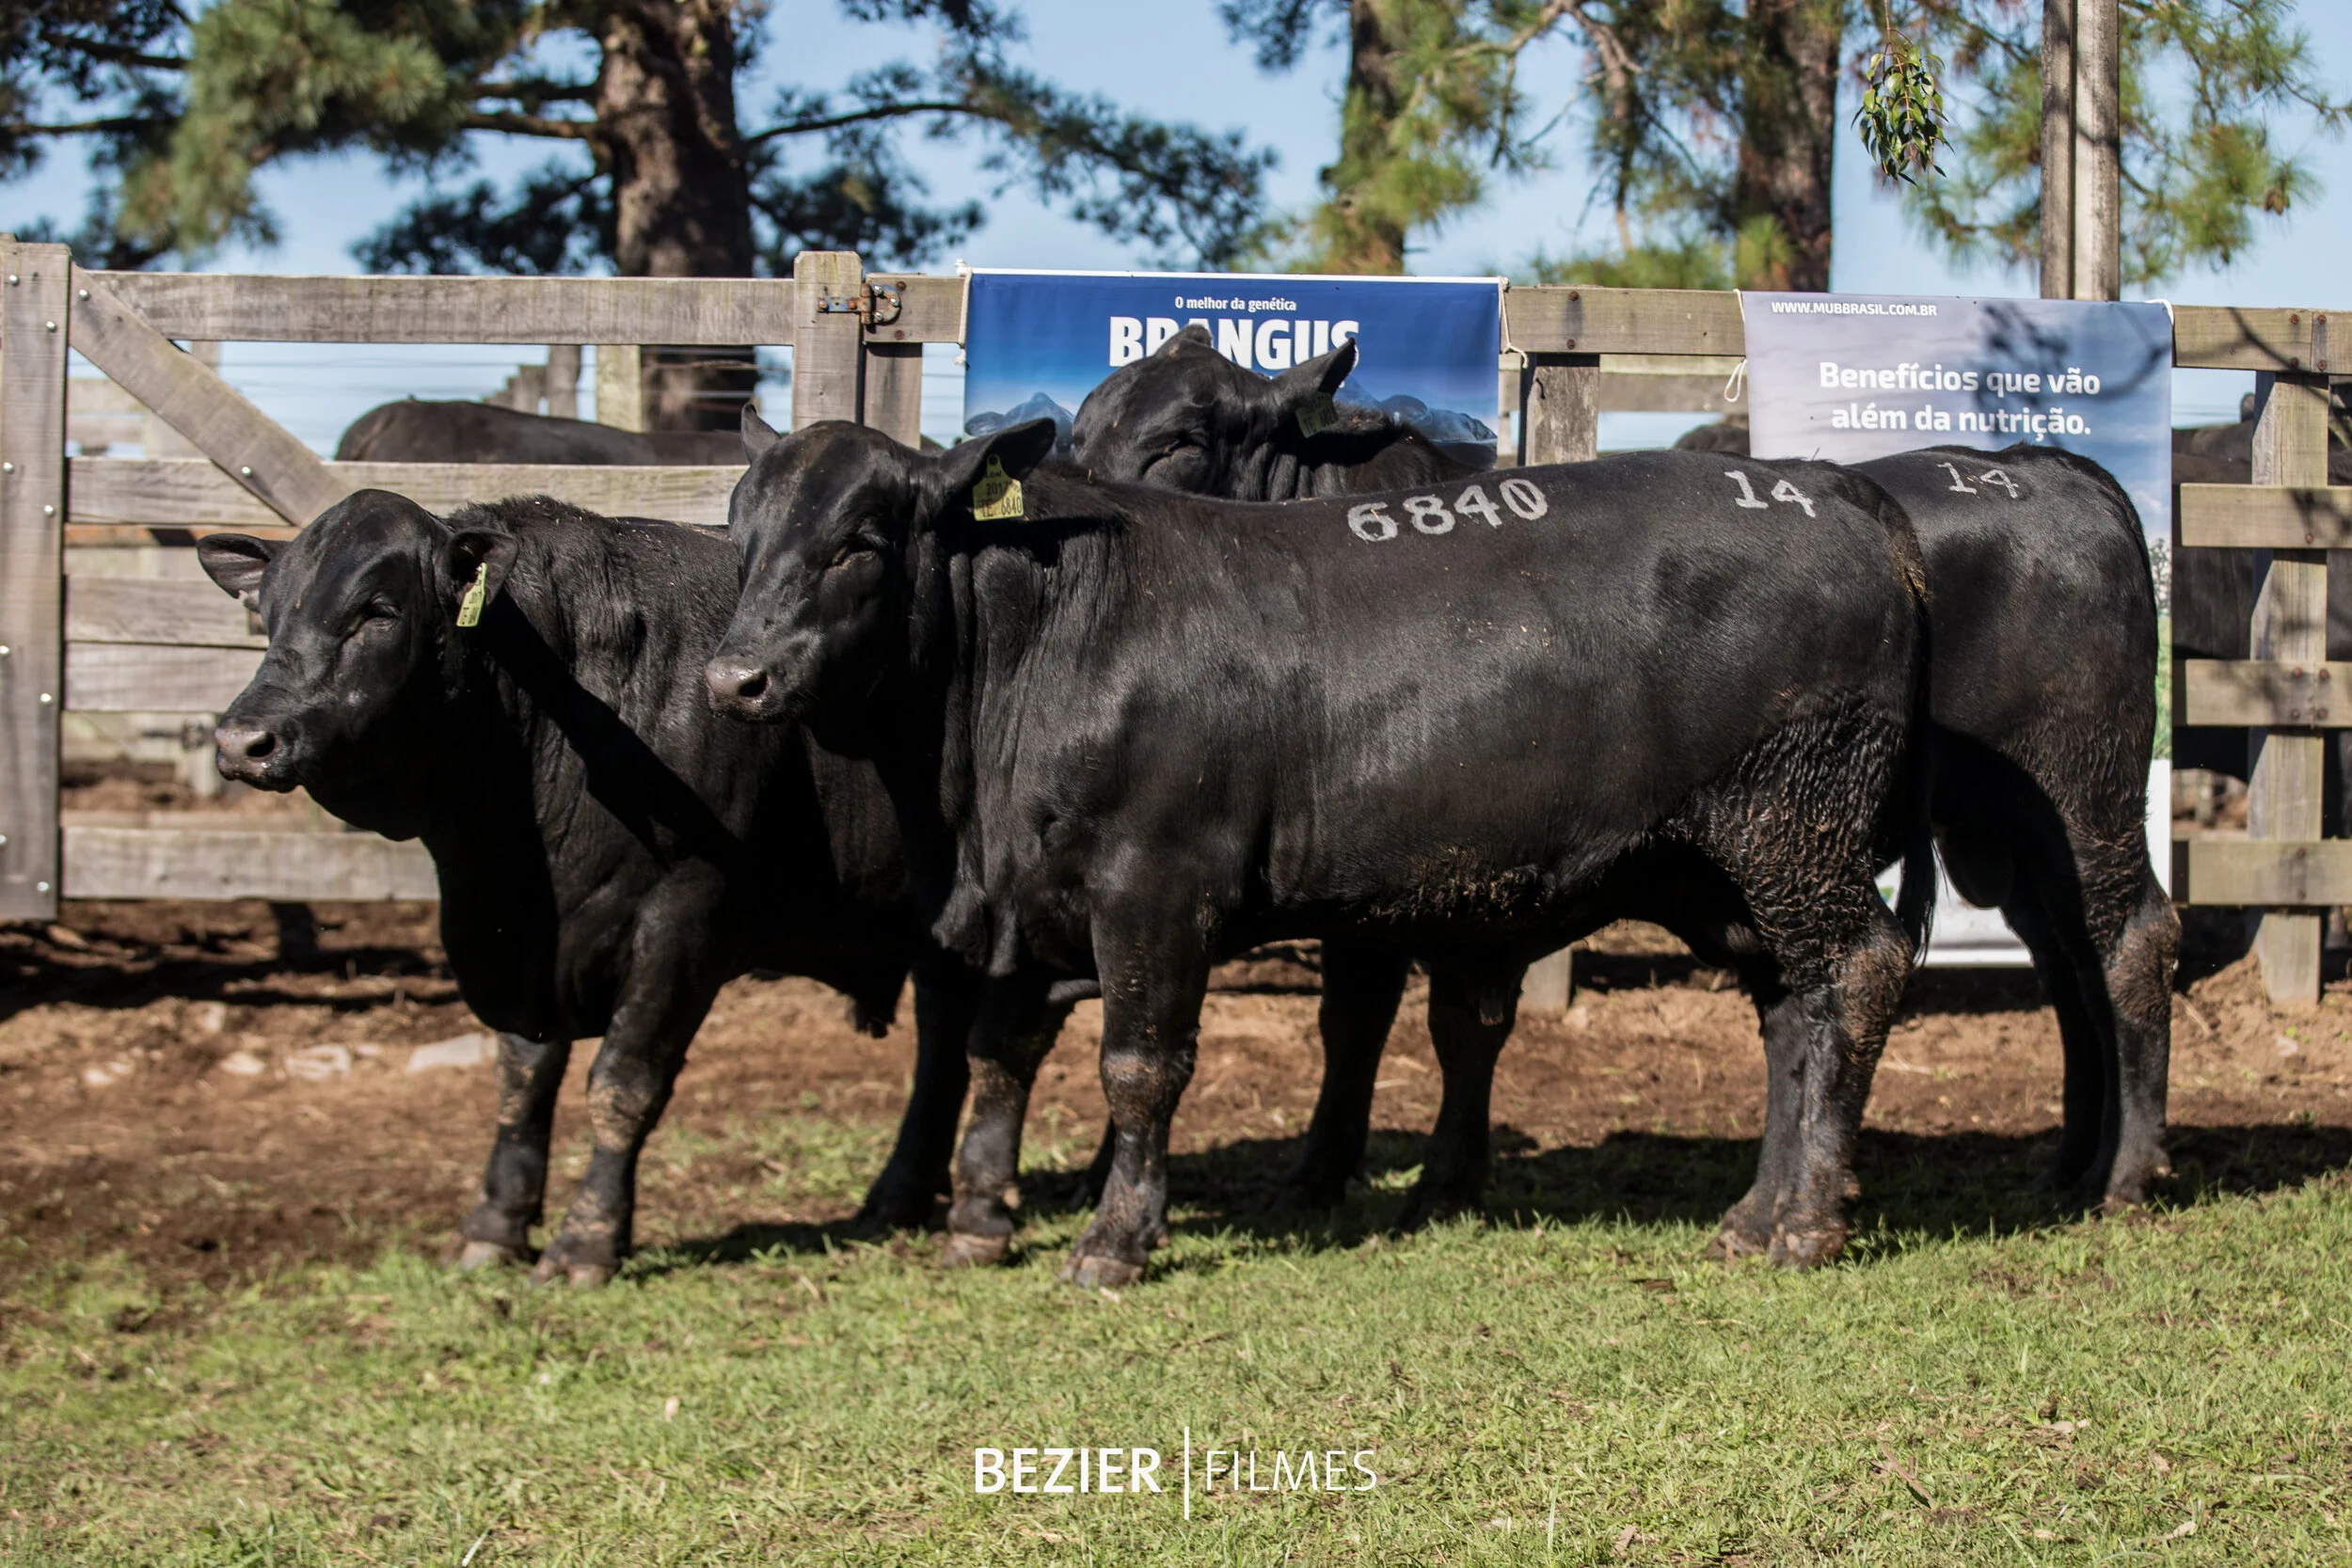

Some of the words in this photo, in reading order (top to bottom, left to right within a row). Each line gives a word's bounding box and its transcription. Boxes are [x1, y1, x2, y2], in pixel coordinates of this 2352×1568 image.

[1174, 296, 1184, 310] O
[1186, 296, 1228, 310] melhor
[1231, 296, 1246, 311] da
[1248, 296, 1297, 313] genética
[1771, 301, 1938, 318] WWW.MUBBRASIL.COM.BR
[1820, 360, 1979, 391] Benefícios
[1986, 371, 2041, 399] que
[2046, 367, 2102, 396] vão
[1831, 402, 1907, 431] além
[1914, 404, 1951, 432] da
[1958, 409, 2091, 442] nutrição.
[1724, 468, 1817, 519] 14
[1936, 461, 2020, 500] 14
[1000, 496, 1024, 516] 6840
[1345, 477, 1549, 545] 6840
